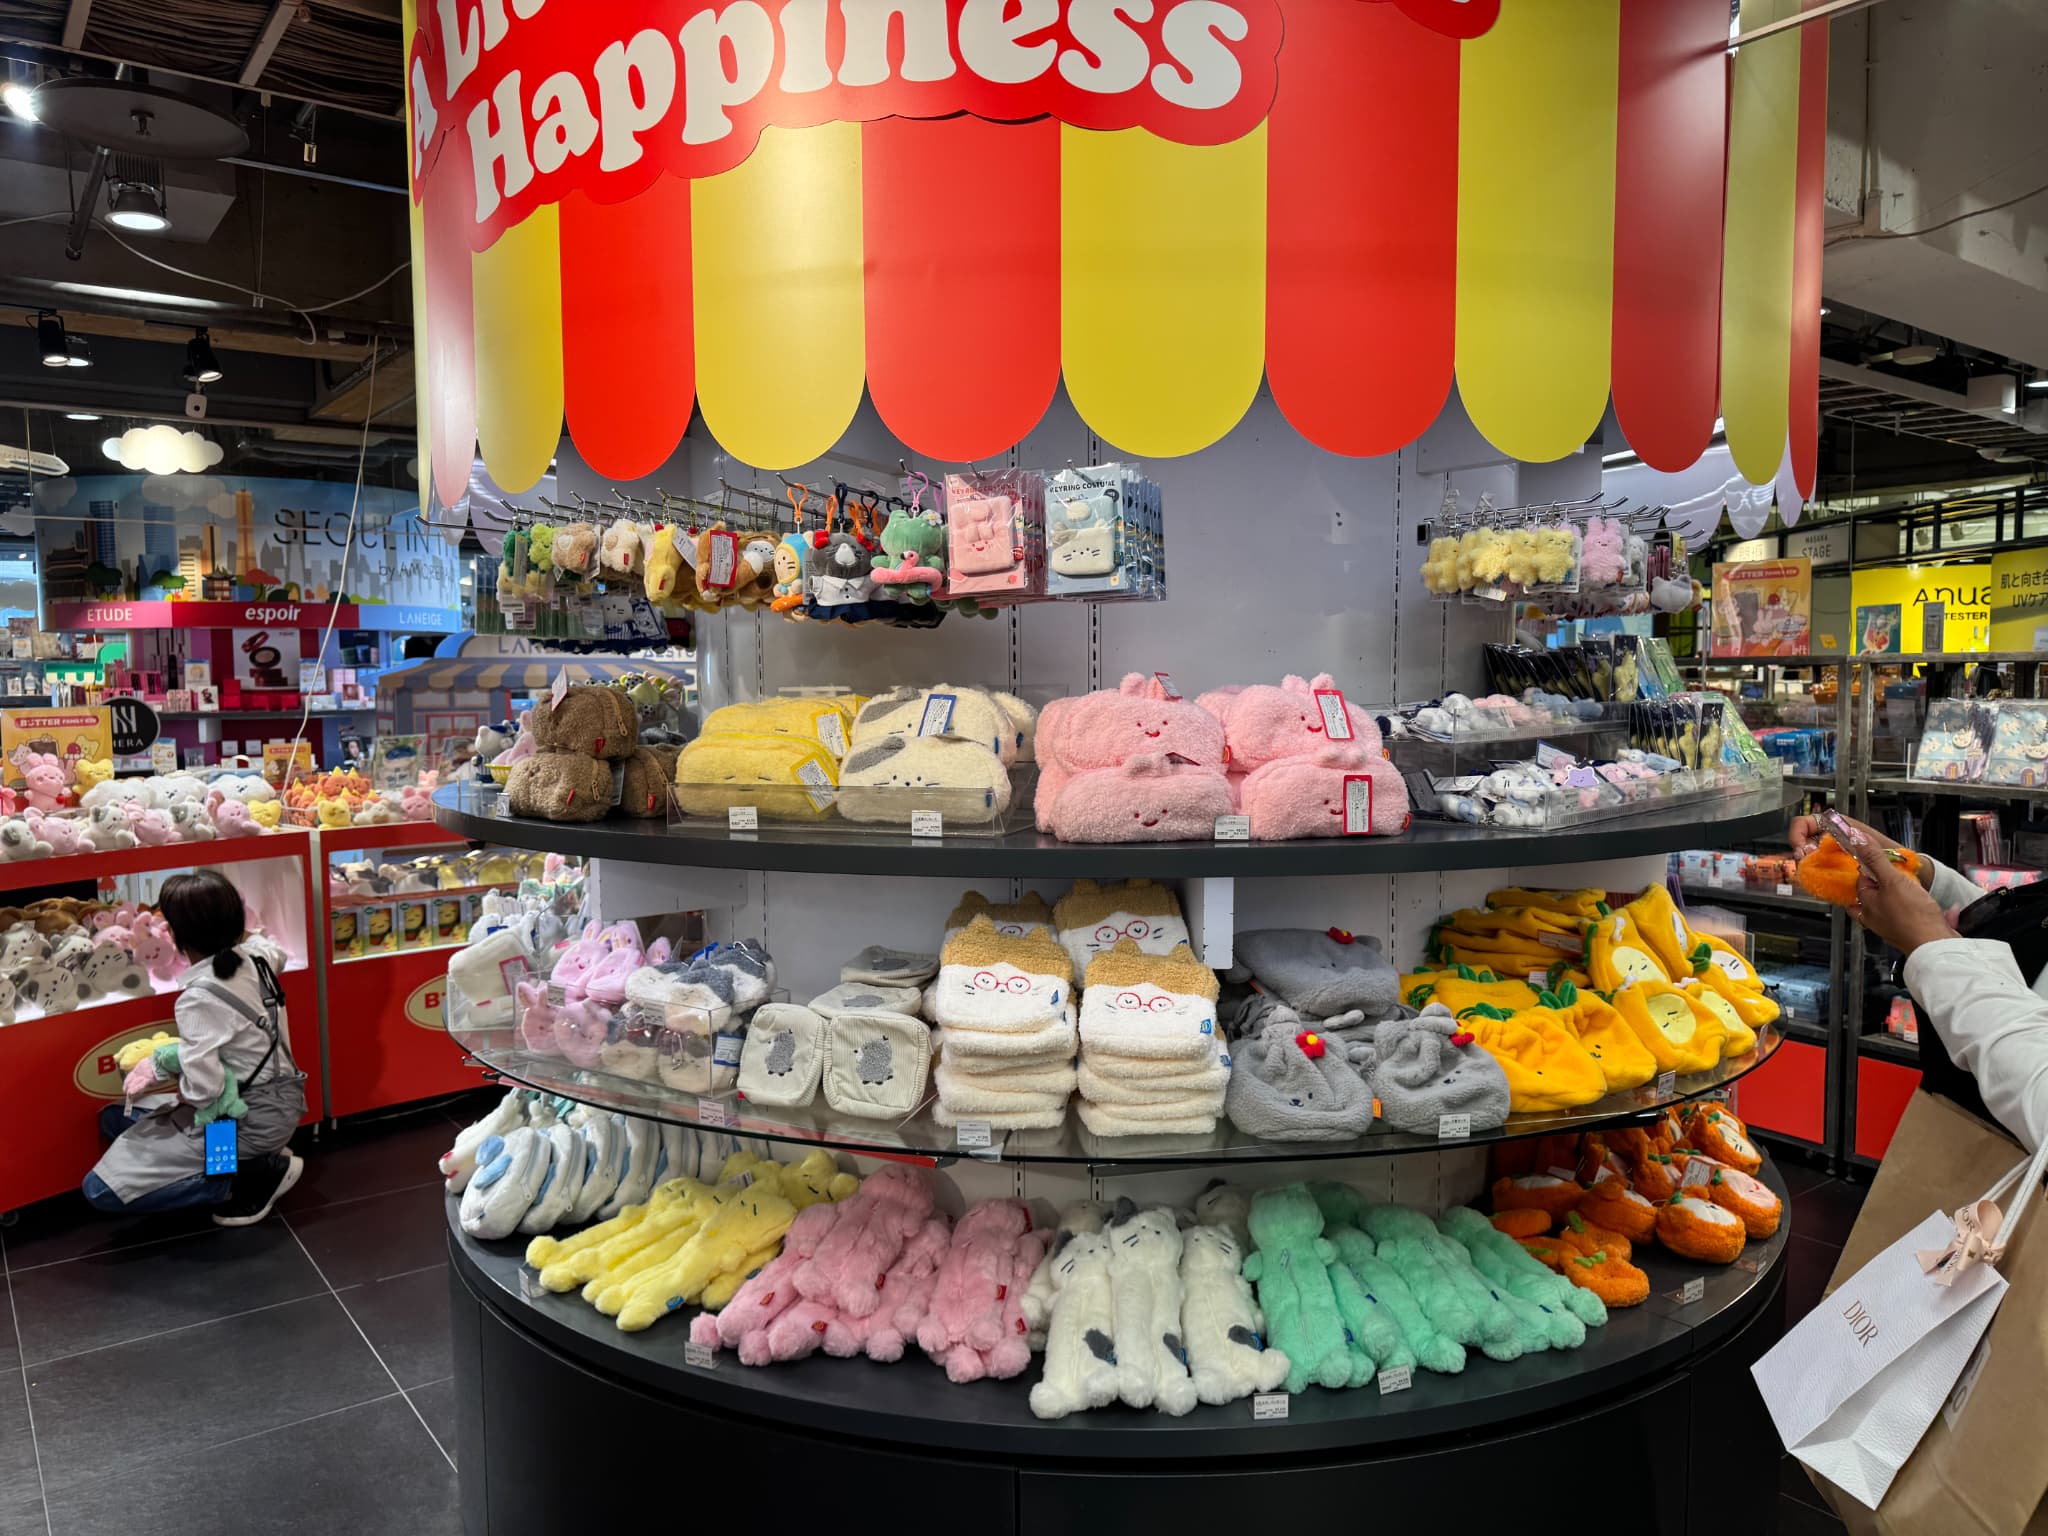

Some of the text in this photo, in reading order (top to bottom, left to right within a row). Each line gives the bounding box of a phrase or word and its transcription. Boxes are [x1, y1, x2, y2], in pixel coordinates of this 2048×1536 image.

[412, 56, 438, 180] A
[466, 0, 1249, 224] Happiness
[273, 508, 397, 550] SEOUL
[1801, 544, 1832, 558] STAGE
[87, 607, 133, 622] ETUDE
[245, 604, 301, 625] espoir
[400, 611, 443, 625] LANEIGE
[1944, 611, 1988, 621] TESTER
[20, 718, 60, 727] BUTTER
[1842, 1299, 1879, 1349] DIOR
